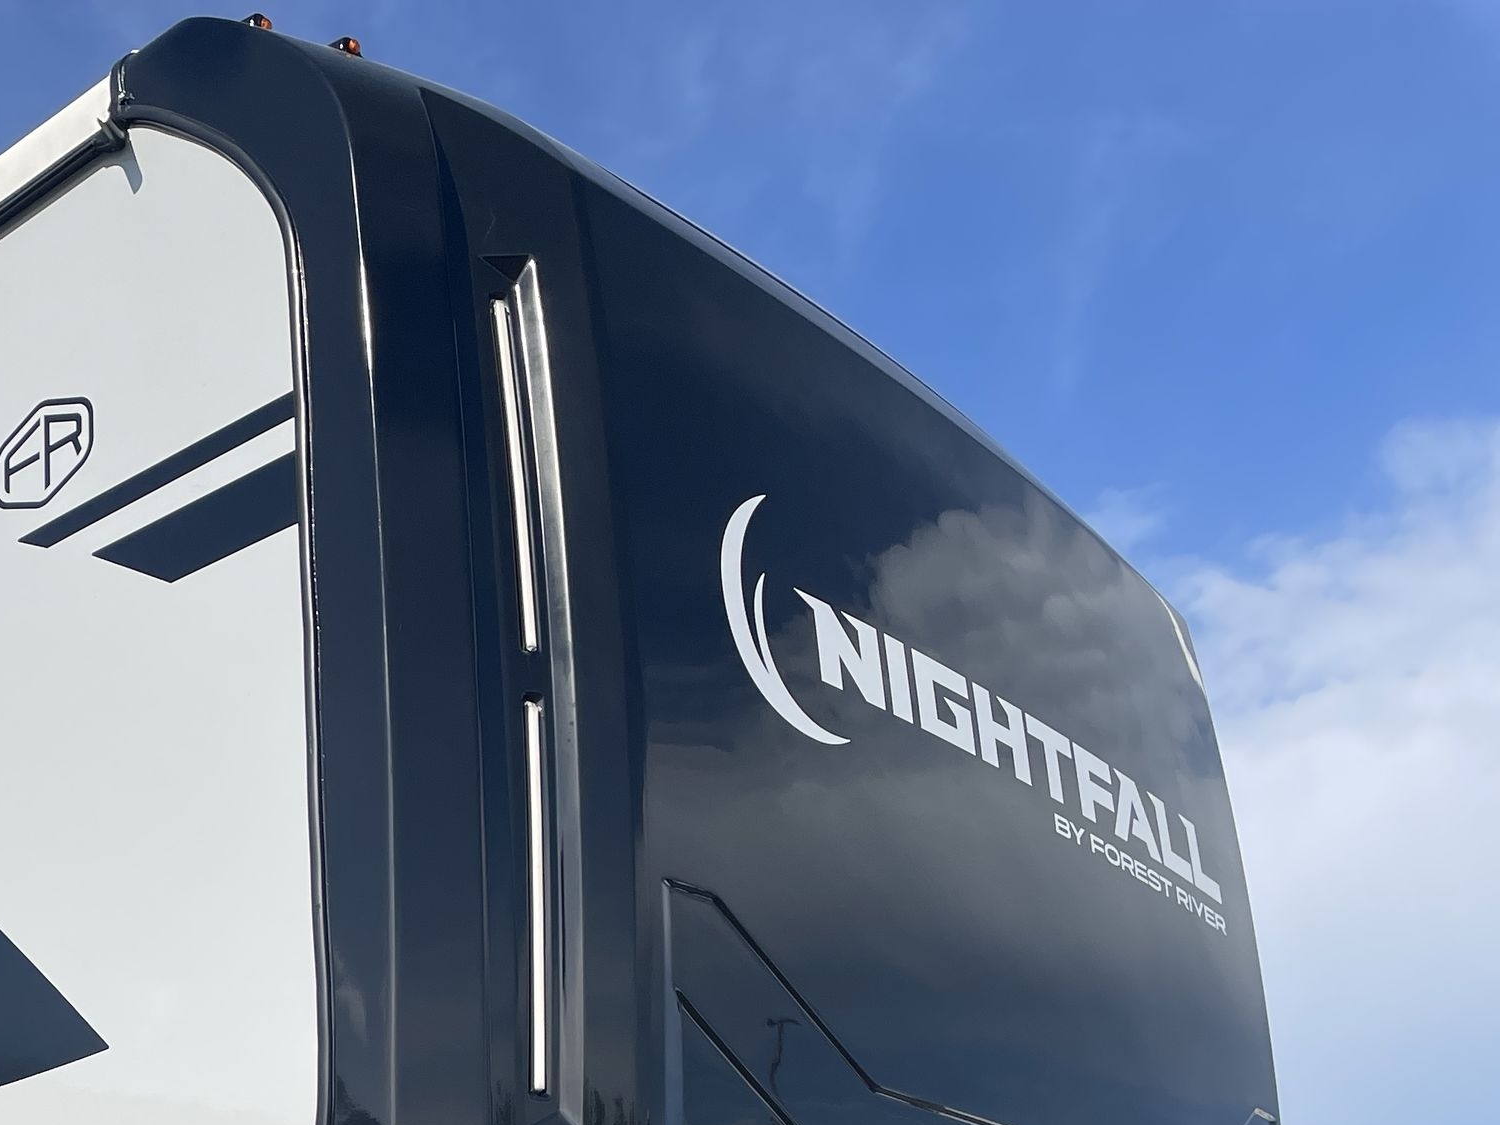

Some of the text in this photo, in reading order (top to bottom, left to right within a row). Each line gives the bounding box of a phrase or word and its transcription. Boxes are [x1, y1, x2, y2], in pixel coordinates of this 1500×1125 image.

[793, 587, 1223, 904] NIGHTFALL
[1053, 812, 1228, 937] BY FOREST RIVER
